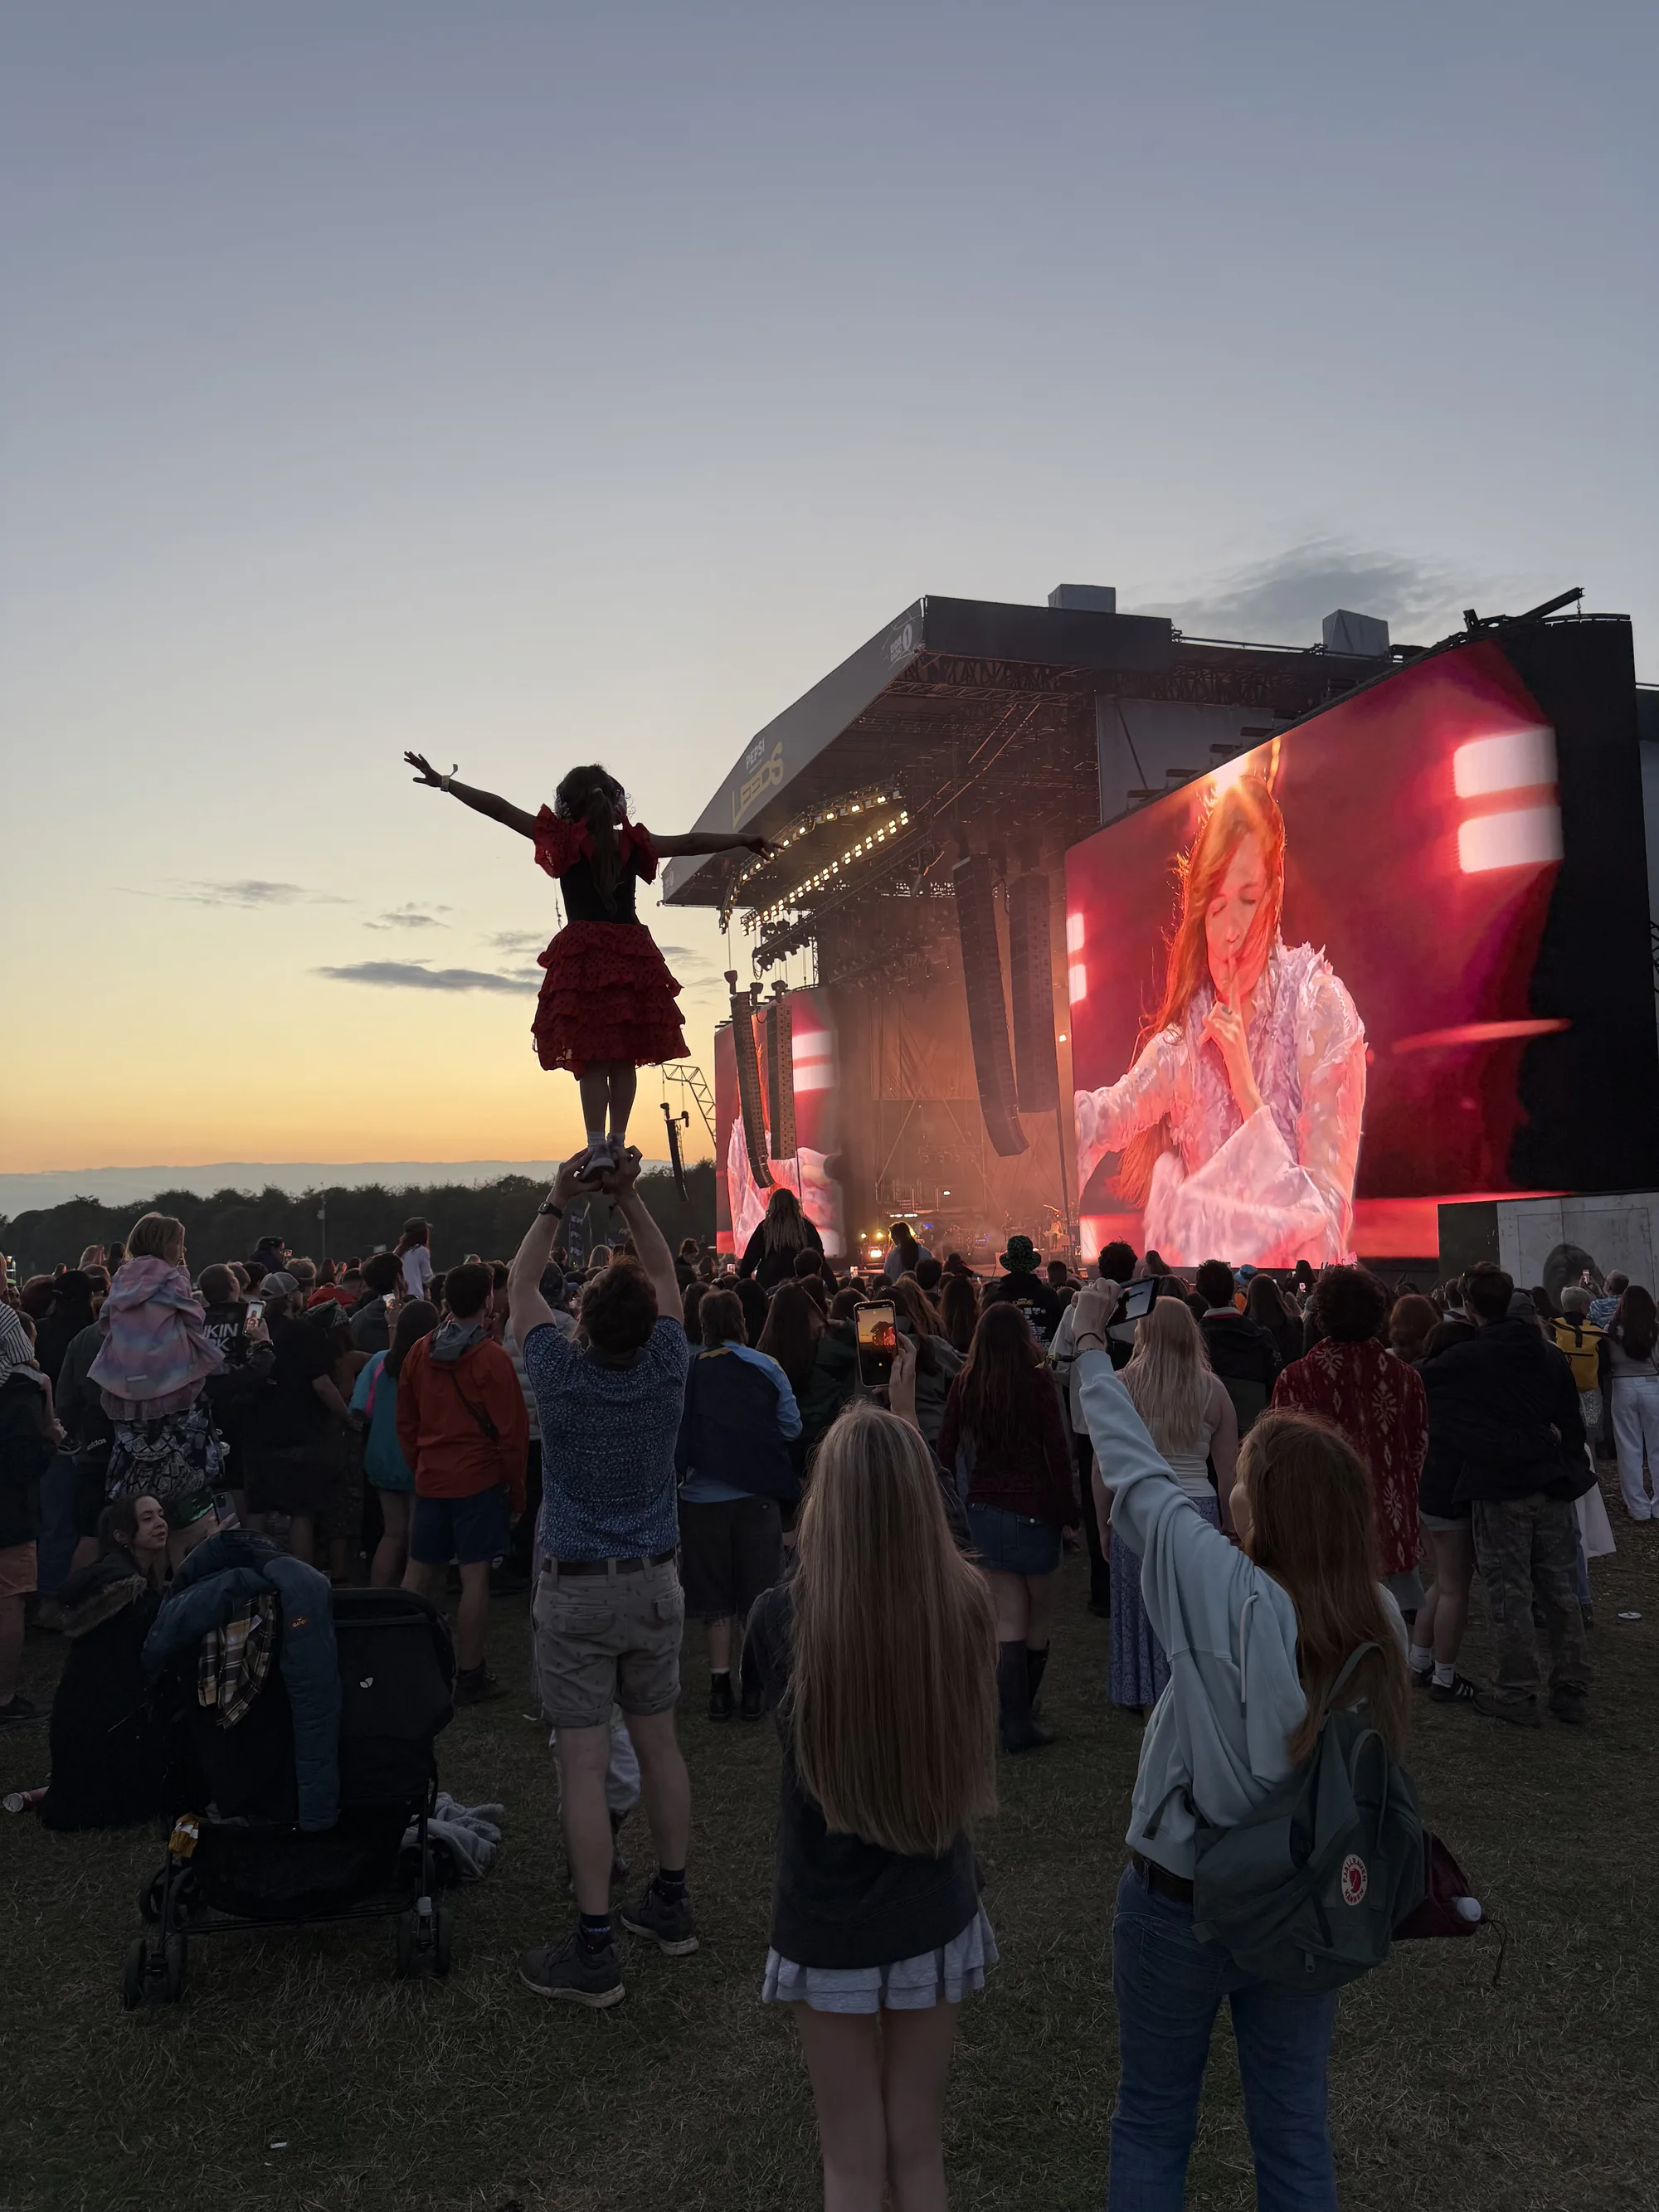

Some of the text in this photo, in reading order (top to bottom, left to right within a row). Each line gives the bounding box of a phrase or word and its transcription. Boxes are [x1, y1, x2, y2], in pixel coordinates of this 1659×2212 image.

[746, 737, 765, 770] PEPSI
[732, 741, 784, 830] LEEDS
[86, 1437, 107, 1451] adidas
